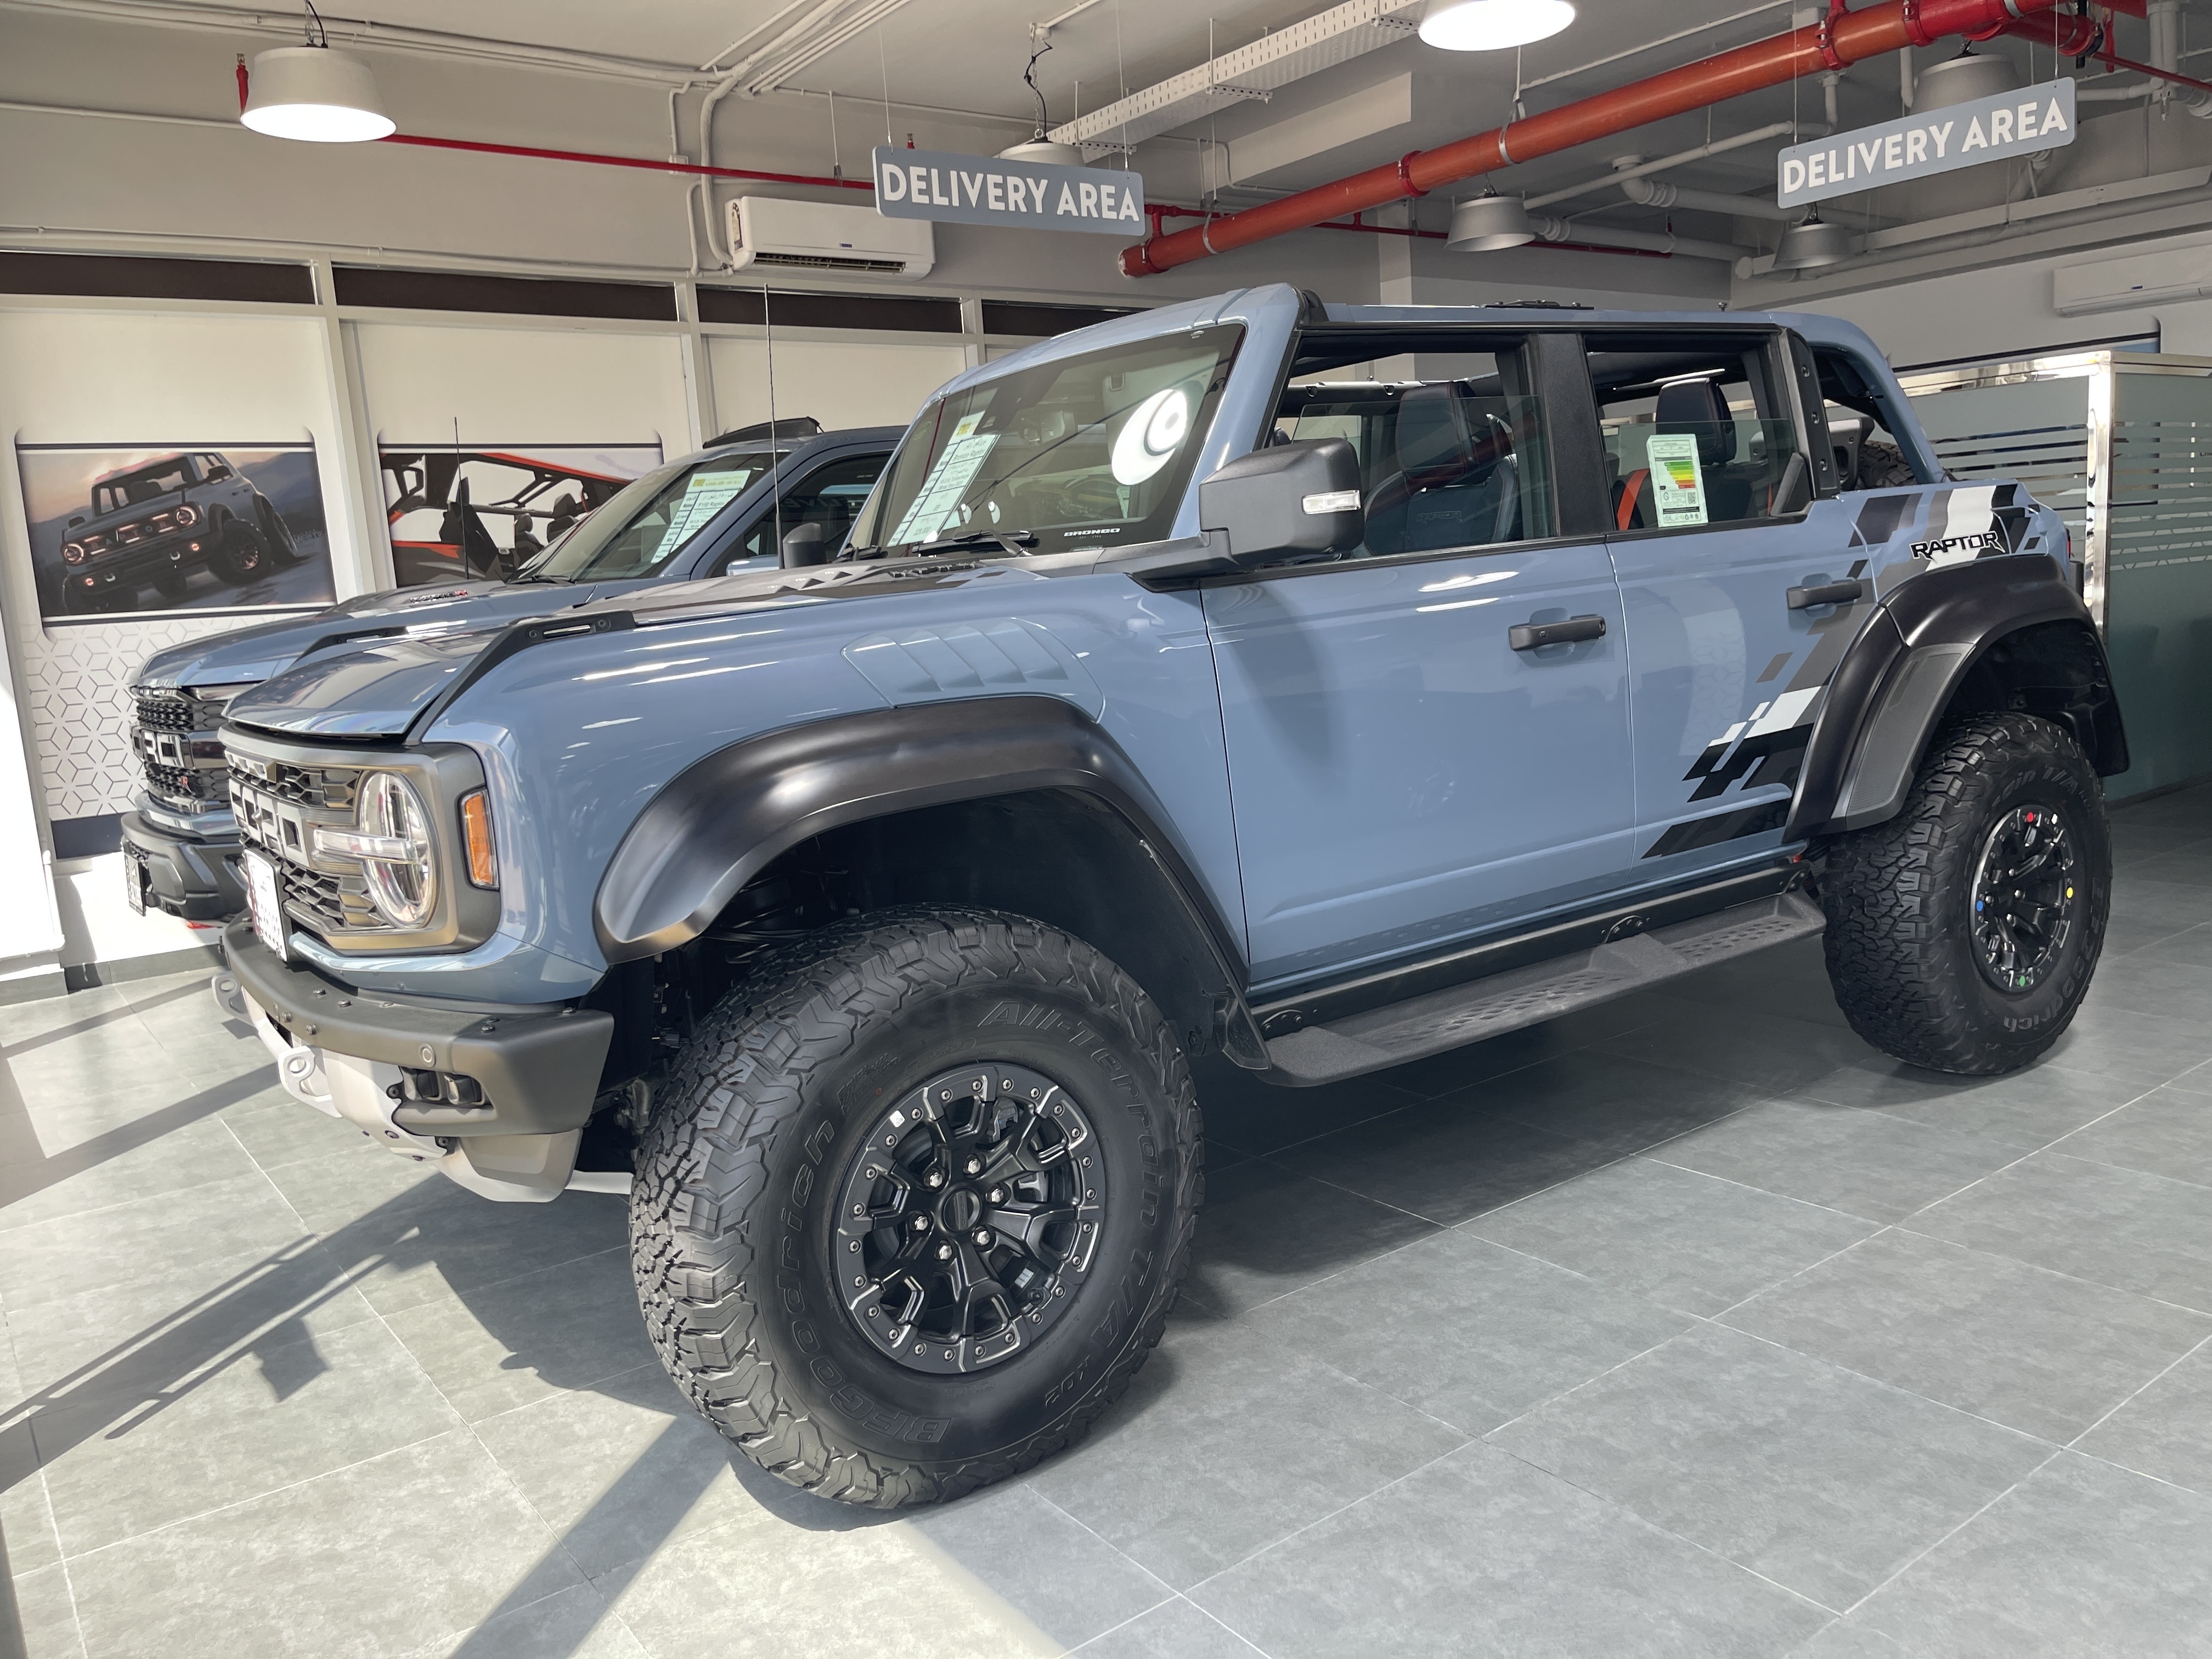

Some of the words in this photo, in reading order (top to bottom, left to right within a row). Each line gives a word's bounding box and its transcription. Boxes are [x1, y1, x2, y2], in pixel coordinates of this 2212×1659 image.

[1784, 120, 1954, 194] DELIVERY
[1961, 97, 2068, 154] AREA
[881, 163, 1048, 214] DELIVERY
[1057, 180, 1140, 222] AREA
[1063, 528, 1121, 537] BRONCO
[1417, 510, 1463, 524] RAPTOR
[1909, 530, 2006, 564] RAPTOR
[978, 1000, 1164, 1227] All-Terrain
[1091, 1248, 1154, 1350] T/A
[777, 1119, 952, 1444] BFGoodrich
